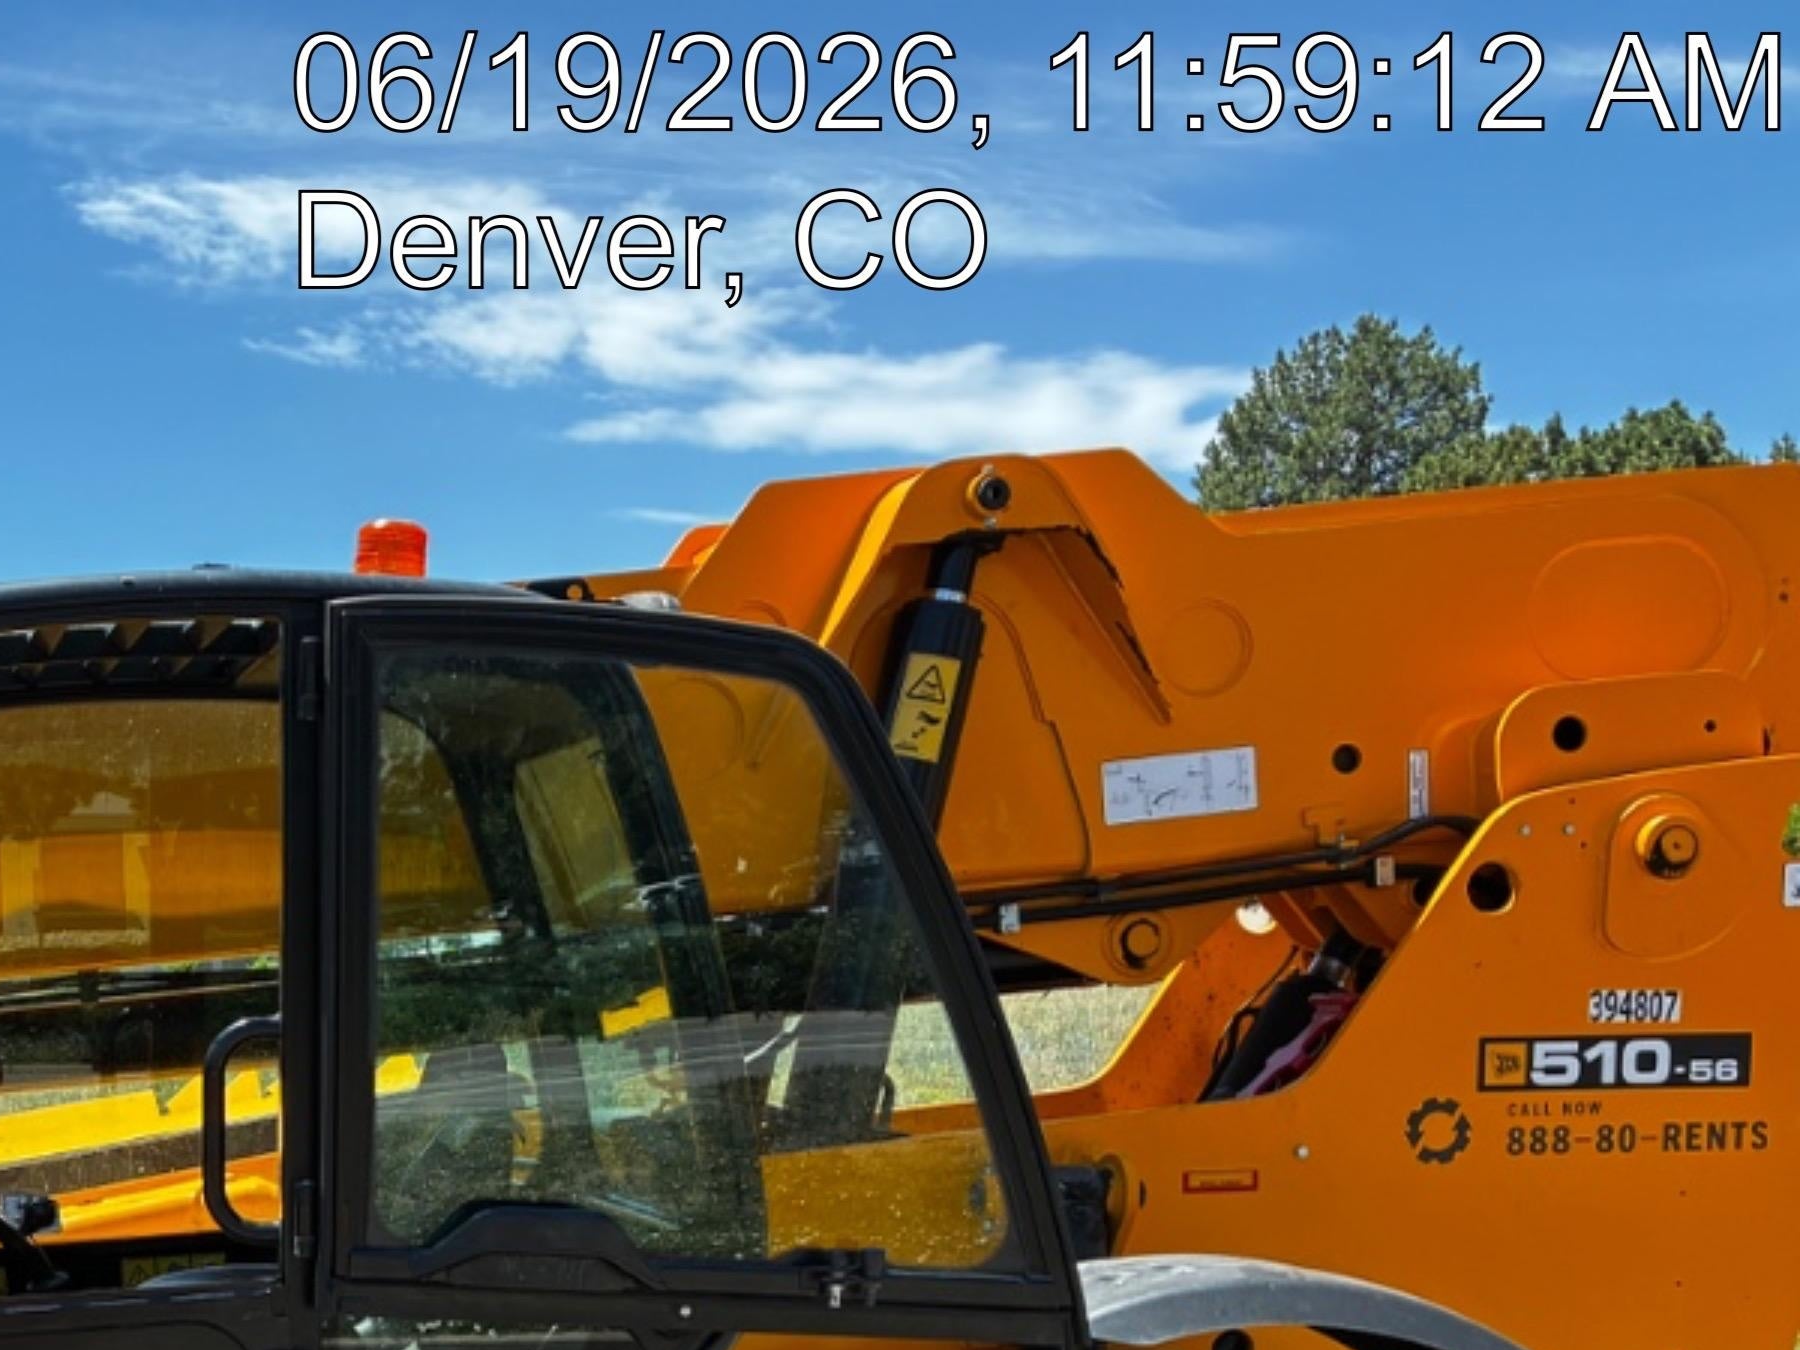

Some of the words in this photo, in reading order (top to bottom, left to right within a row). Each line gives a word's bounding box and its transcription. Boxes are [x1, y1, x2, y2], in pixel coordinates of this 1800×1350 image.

[1590, 989, 1680, 1023] 394807
[1530, 1039, 1738, 1086] 510-56
[1507, 1103, 1552, 1117] CALL
[1562, 1101, 1603, 1115] NOW
[1506, 1121, 1769, 1156] 888-80-RENTS
